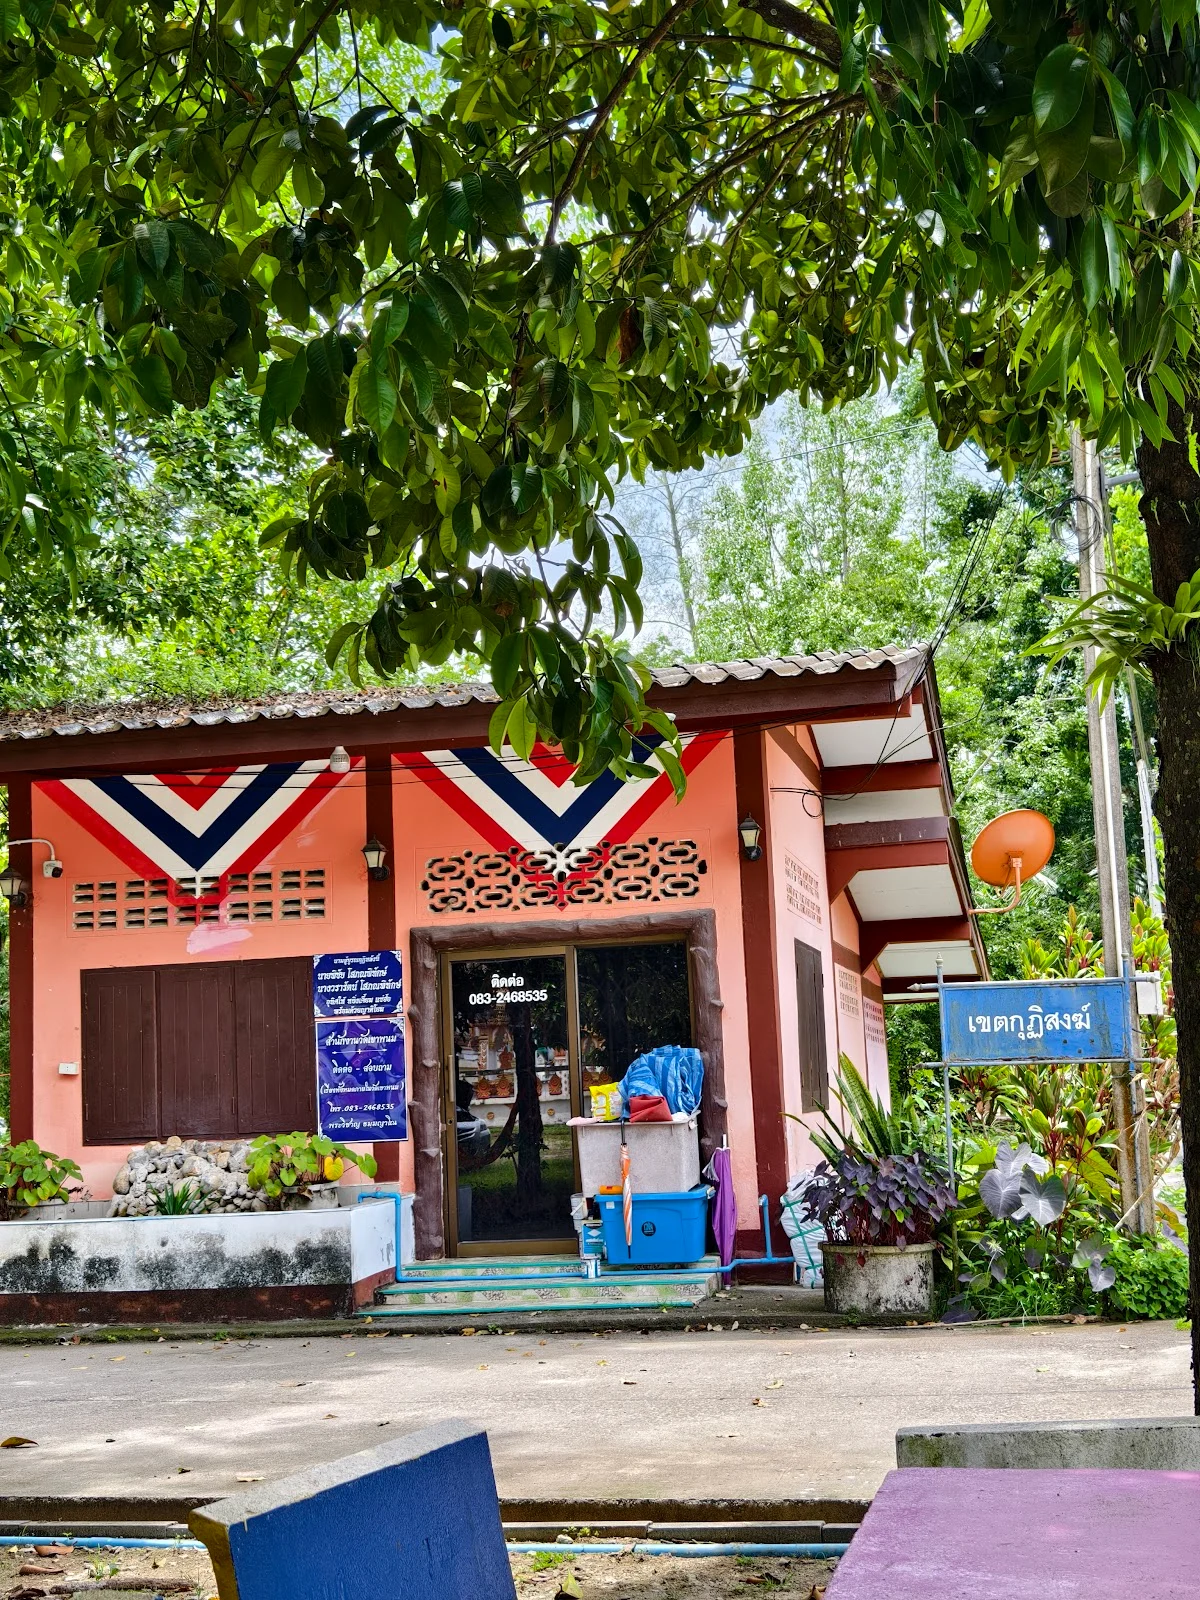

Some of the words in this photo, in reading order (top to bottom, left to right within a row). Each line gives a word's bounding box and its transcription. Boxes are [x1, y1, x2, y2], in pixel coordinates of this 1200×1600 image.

[491, 972, 524, 988] ติดต่อ
[469, 989, 548, 1005] 083-2468535
[968, 1002, 1091, 1040] เขตกุฏิสงฆ์
[325, 1029, 397, 1046] สำนักงานวัดเขาพนม
[332, 1059, 353, 1074] ติดต่อ
[363, 1059, 392, 1072] สอบถาม
